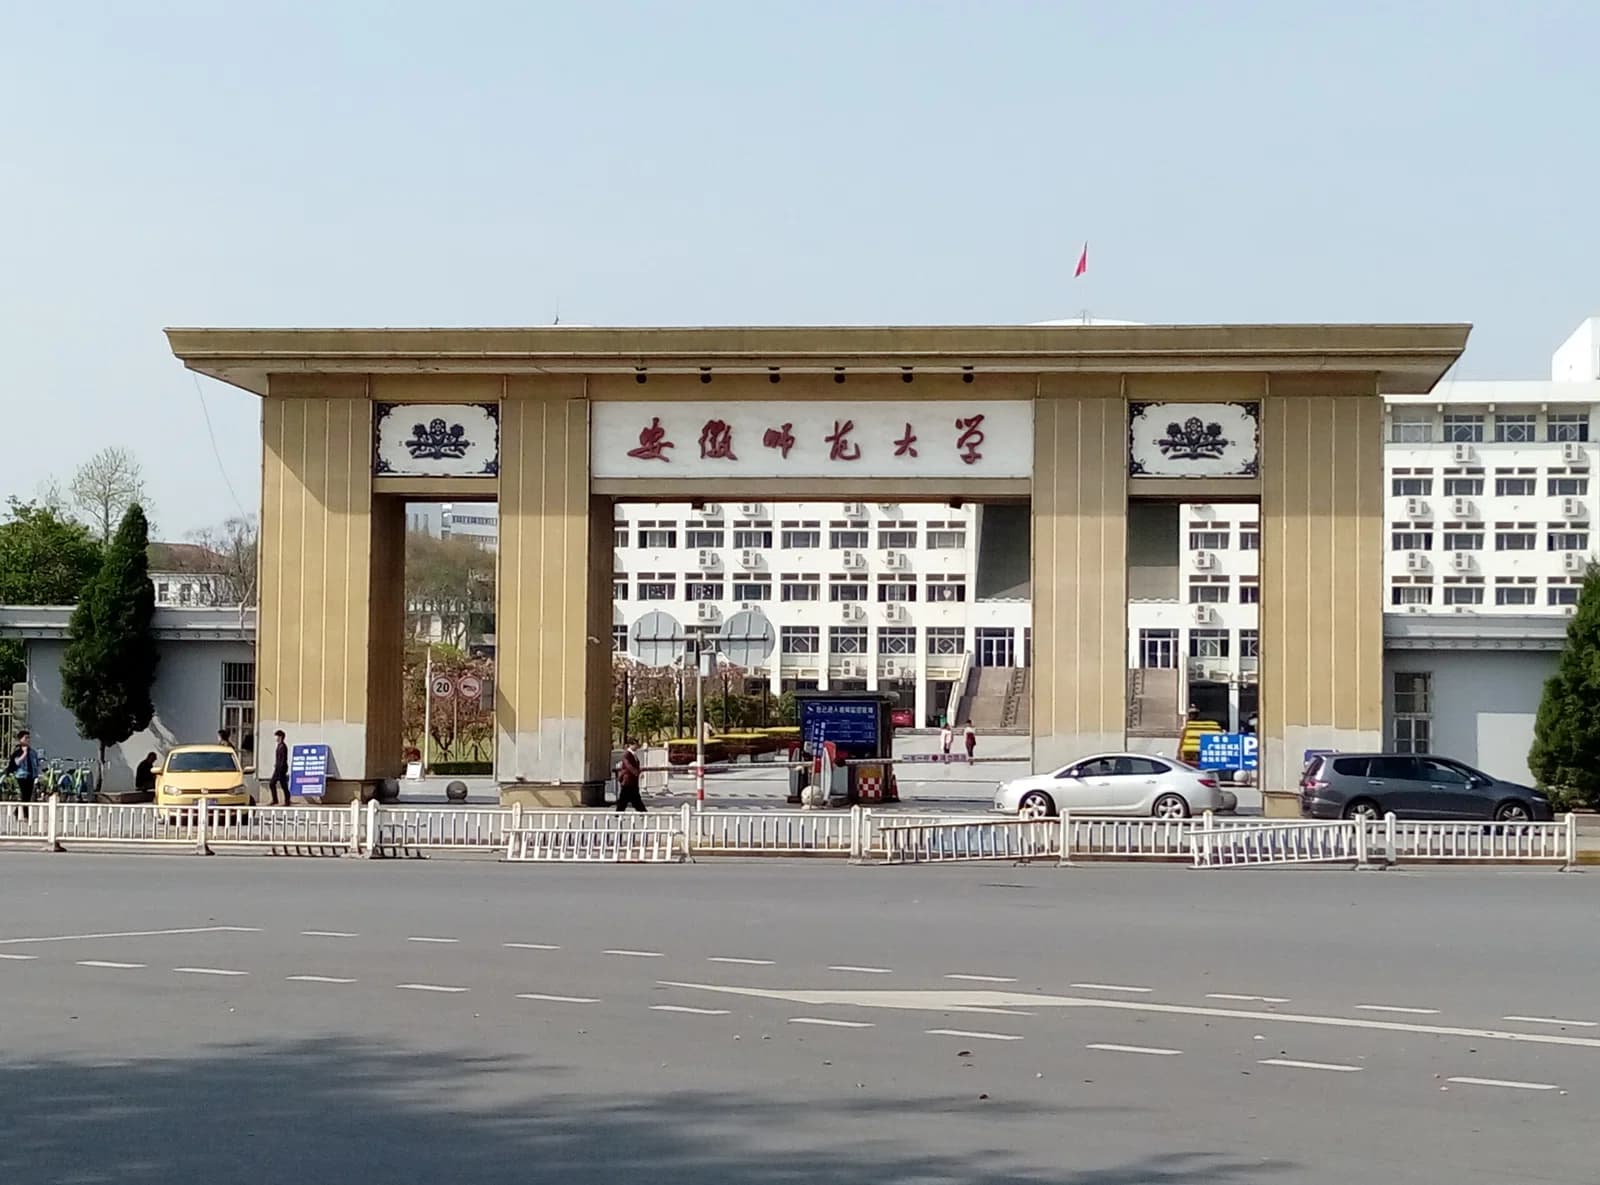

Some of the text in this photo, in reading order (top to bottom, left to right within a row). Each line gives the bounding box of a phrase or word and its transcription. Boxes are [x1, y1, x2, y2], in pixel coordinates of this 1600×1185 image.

[627, 414, 985, 464] 安徽师范大学
[436, 681, 450, 693] 20
[1243, 736, 1258, 756] P
